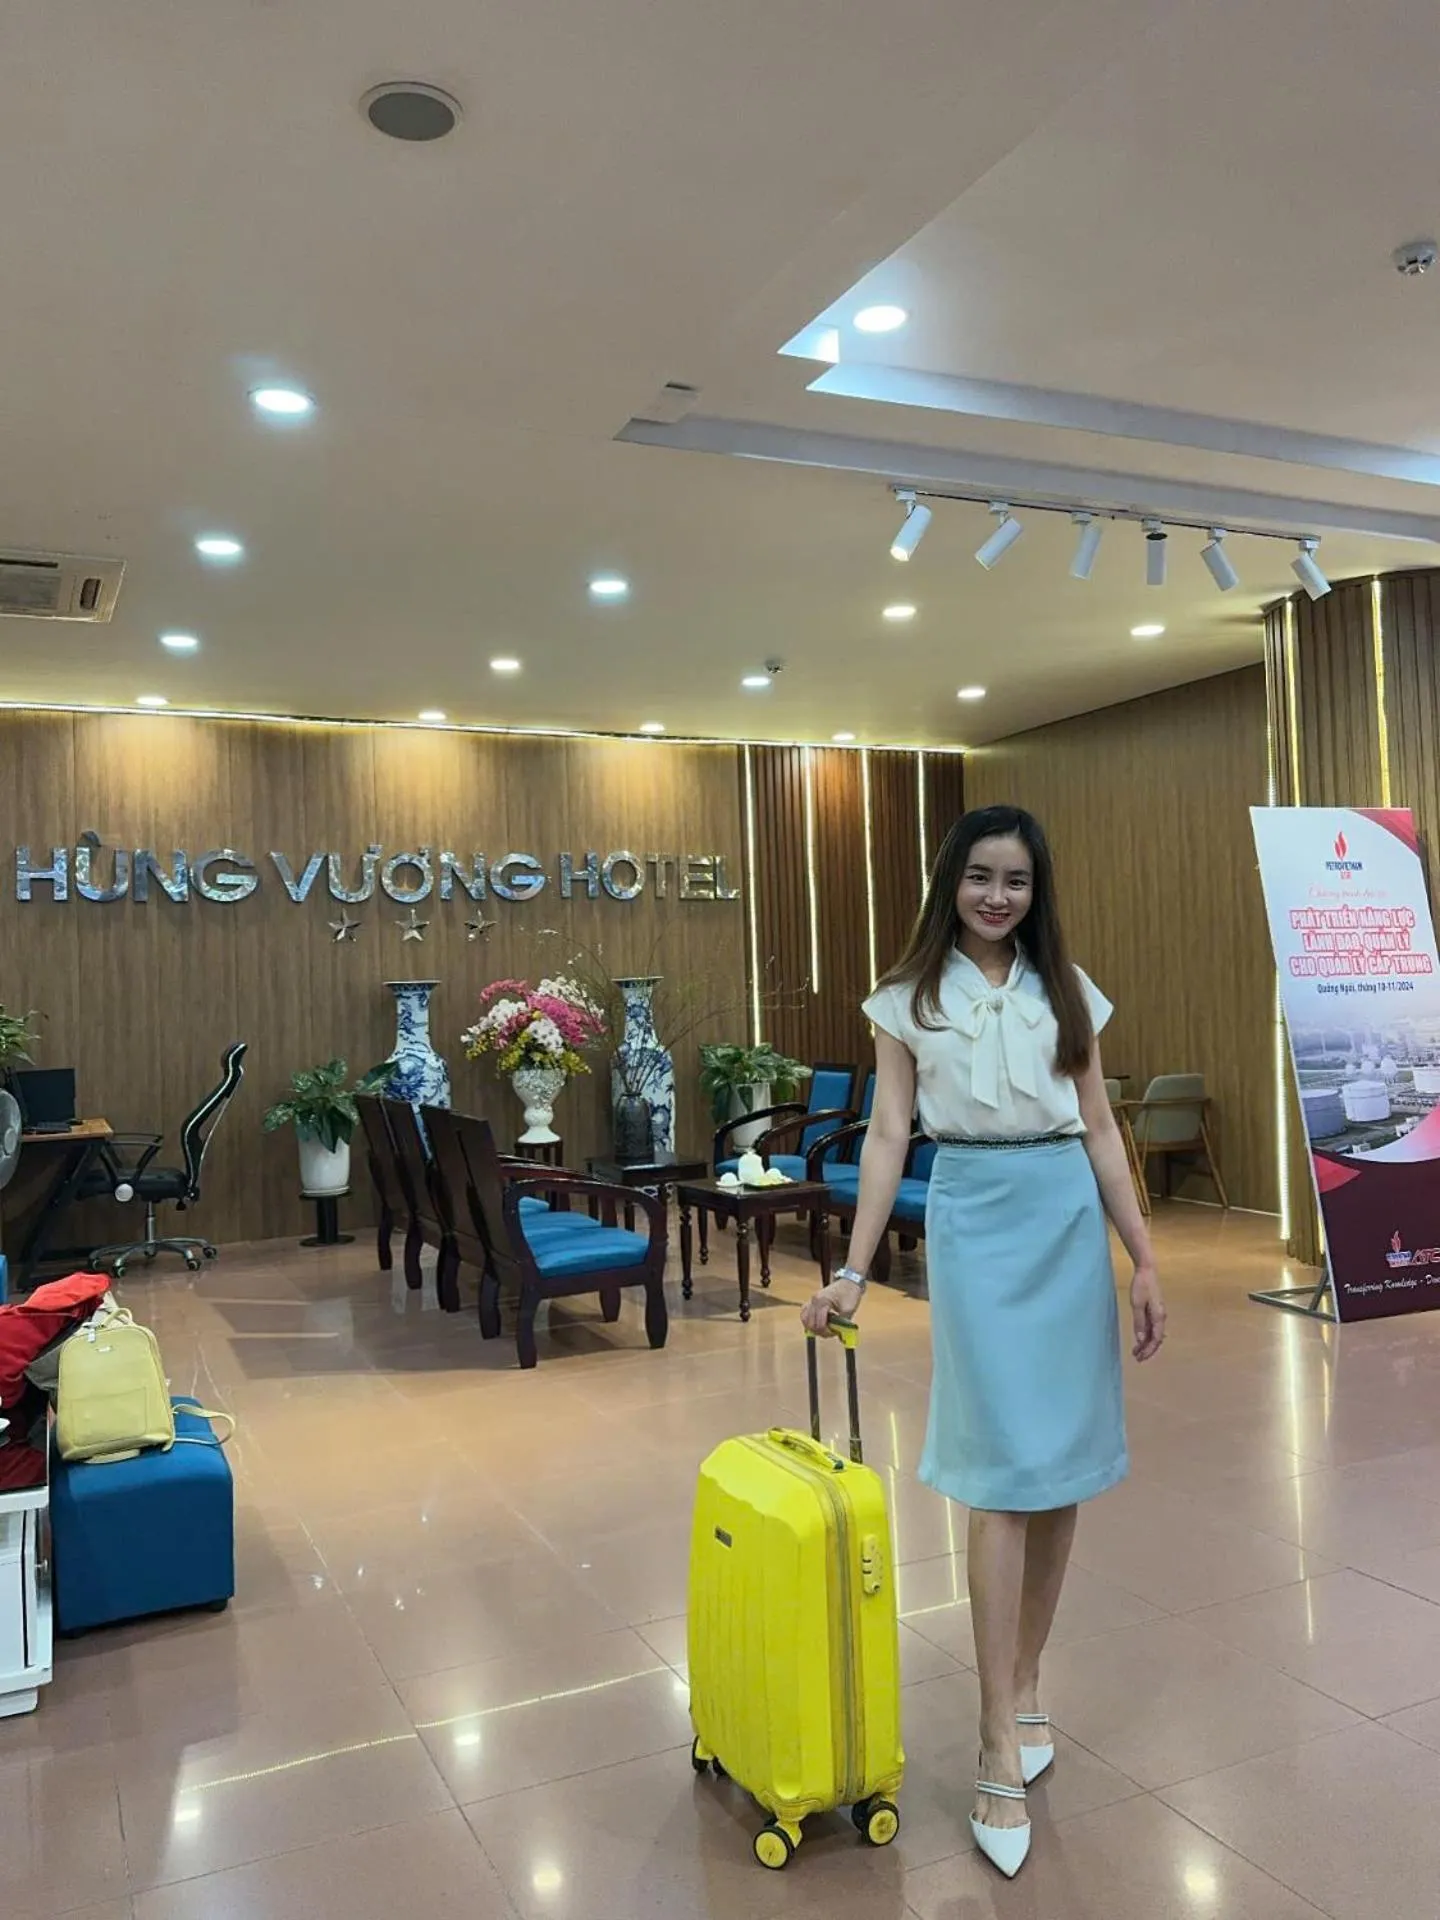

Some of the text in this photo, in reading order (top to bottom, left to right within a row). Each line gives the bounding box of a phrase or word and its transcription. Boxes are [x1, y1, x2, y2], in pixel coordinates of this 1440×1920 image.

[15, 830, 740, 903] HÙNG VƯƠNG HOTEL
[1290, 907, 1322, 929] PHÁT
[1290, 956, 1316, 976] CHO
[1392, 954, 1432, 974] TRUNG
